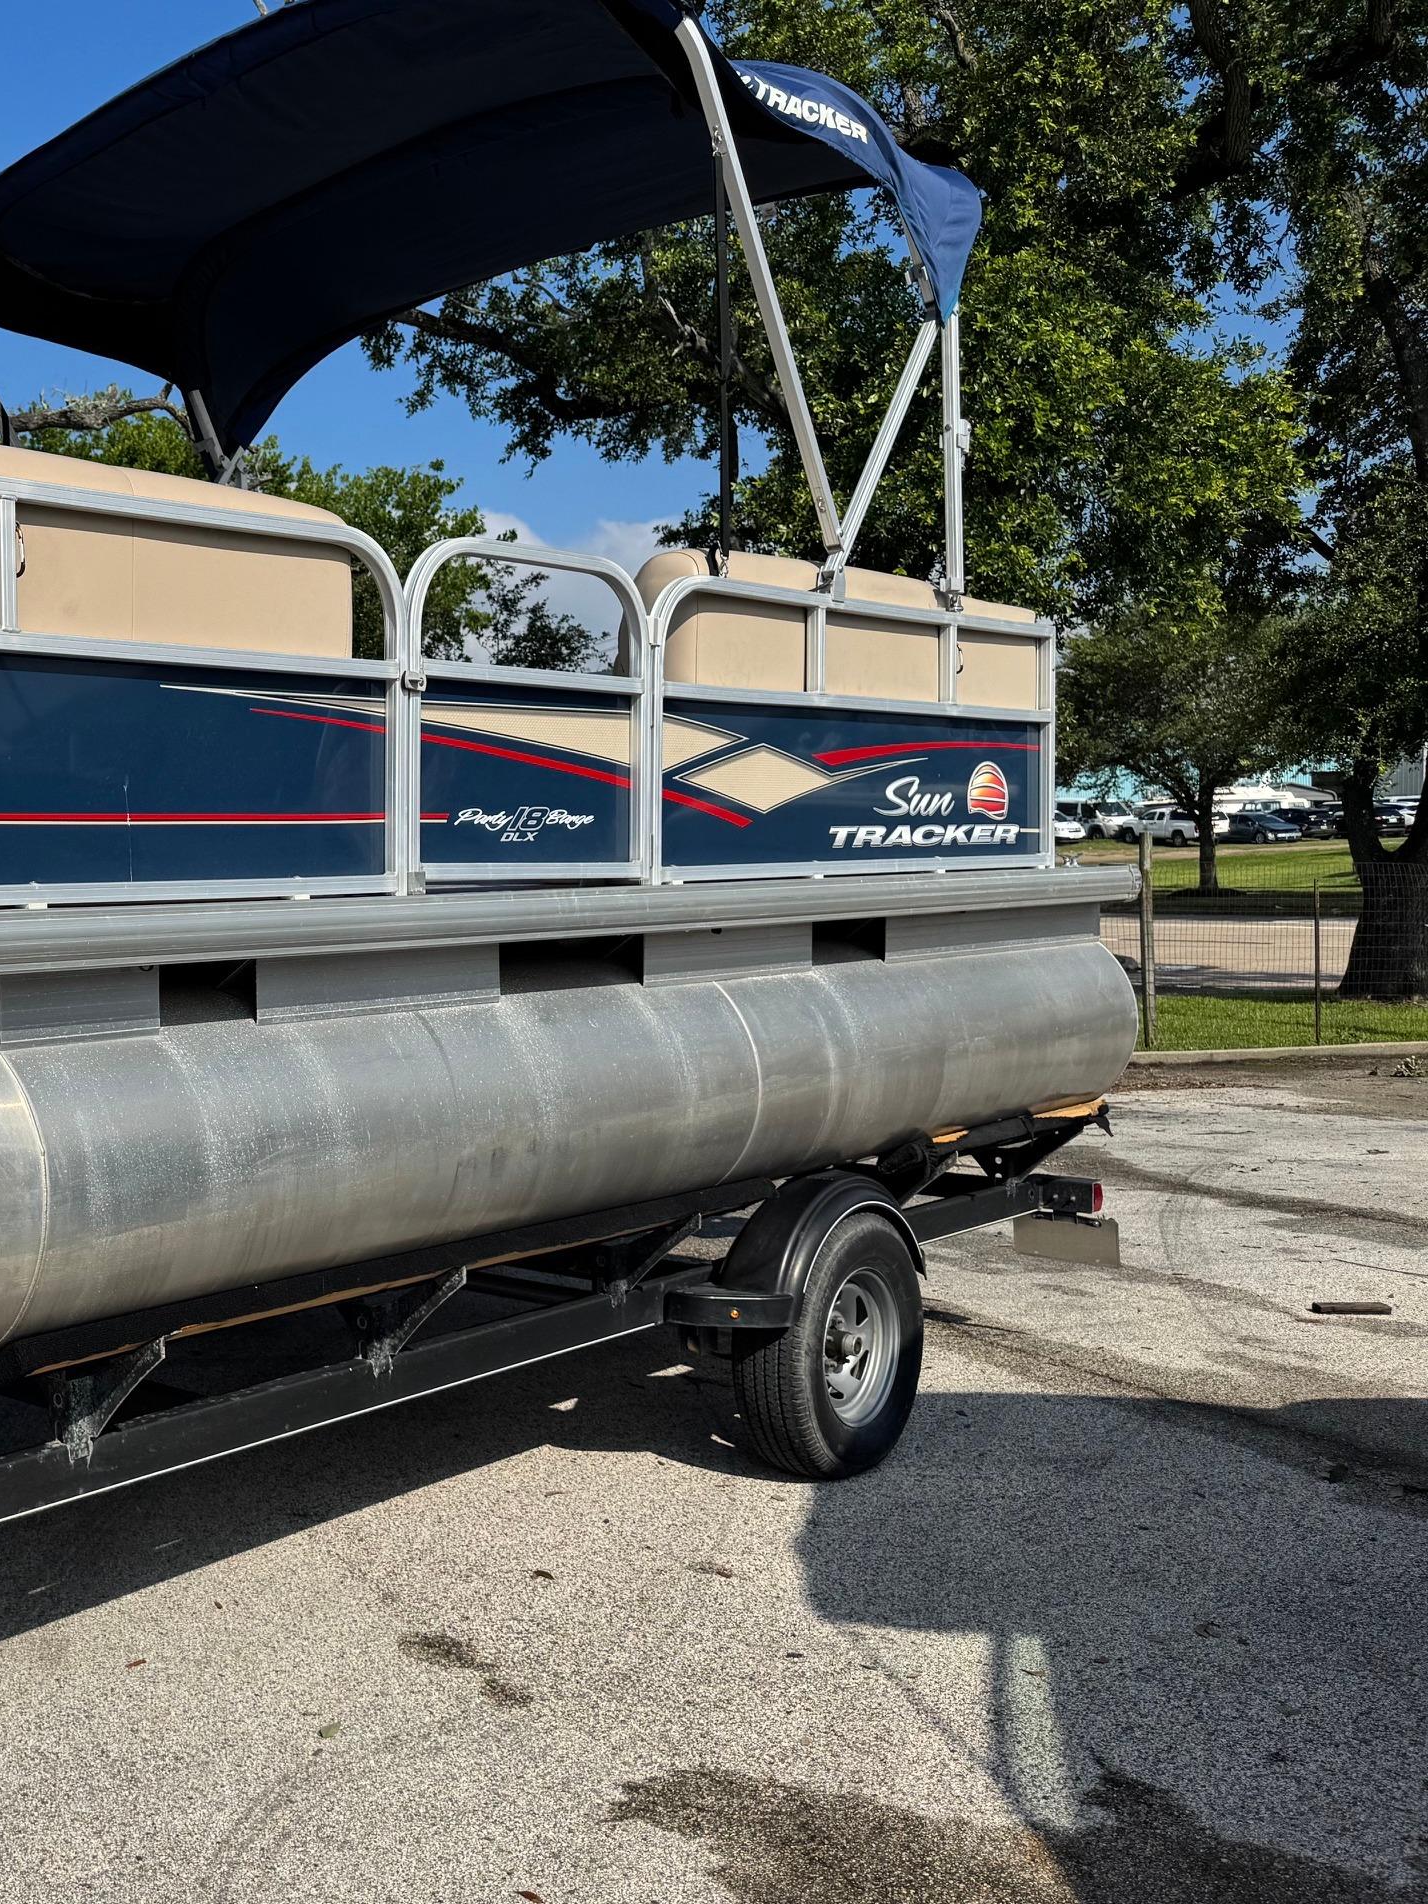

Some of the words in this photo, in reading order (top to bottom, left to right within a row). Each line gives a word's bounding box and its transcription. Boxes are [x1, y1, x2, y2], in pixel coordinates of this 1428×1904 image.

[754, 75, 869, 145] TRACKER
[873, 775, 955, 817] Sun
[454, 808, 514, 832] Party
[506, 806, 551, 832] 18
[545, 809, 595, 830] Barge
[500, 832, 539, 842] DLX
[828, 823, 1020, 849] TRACKER
